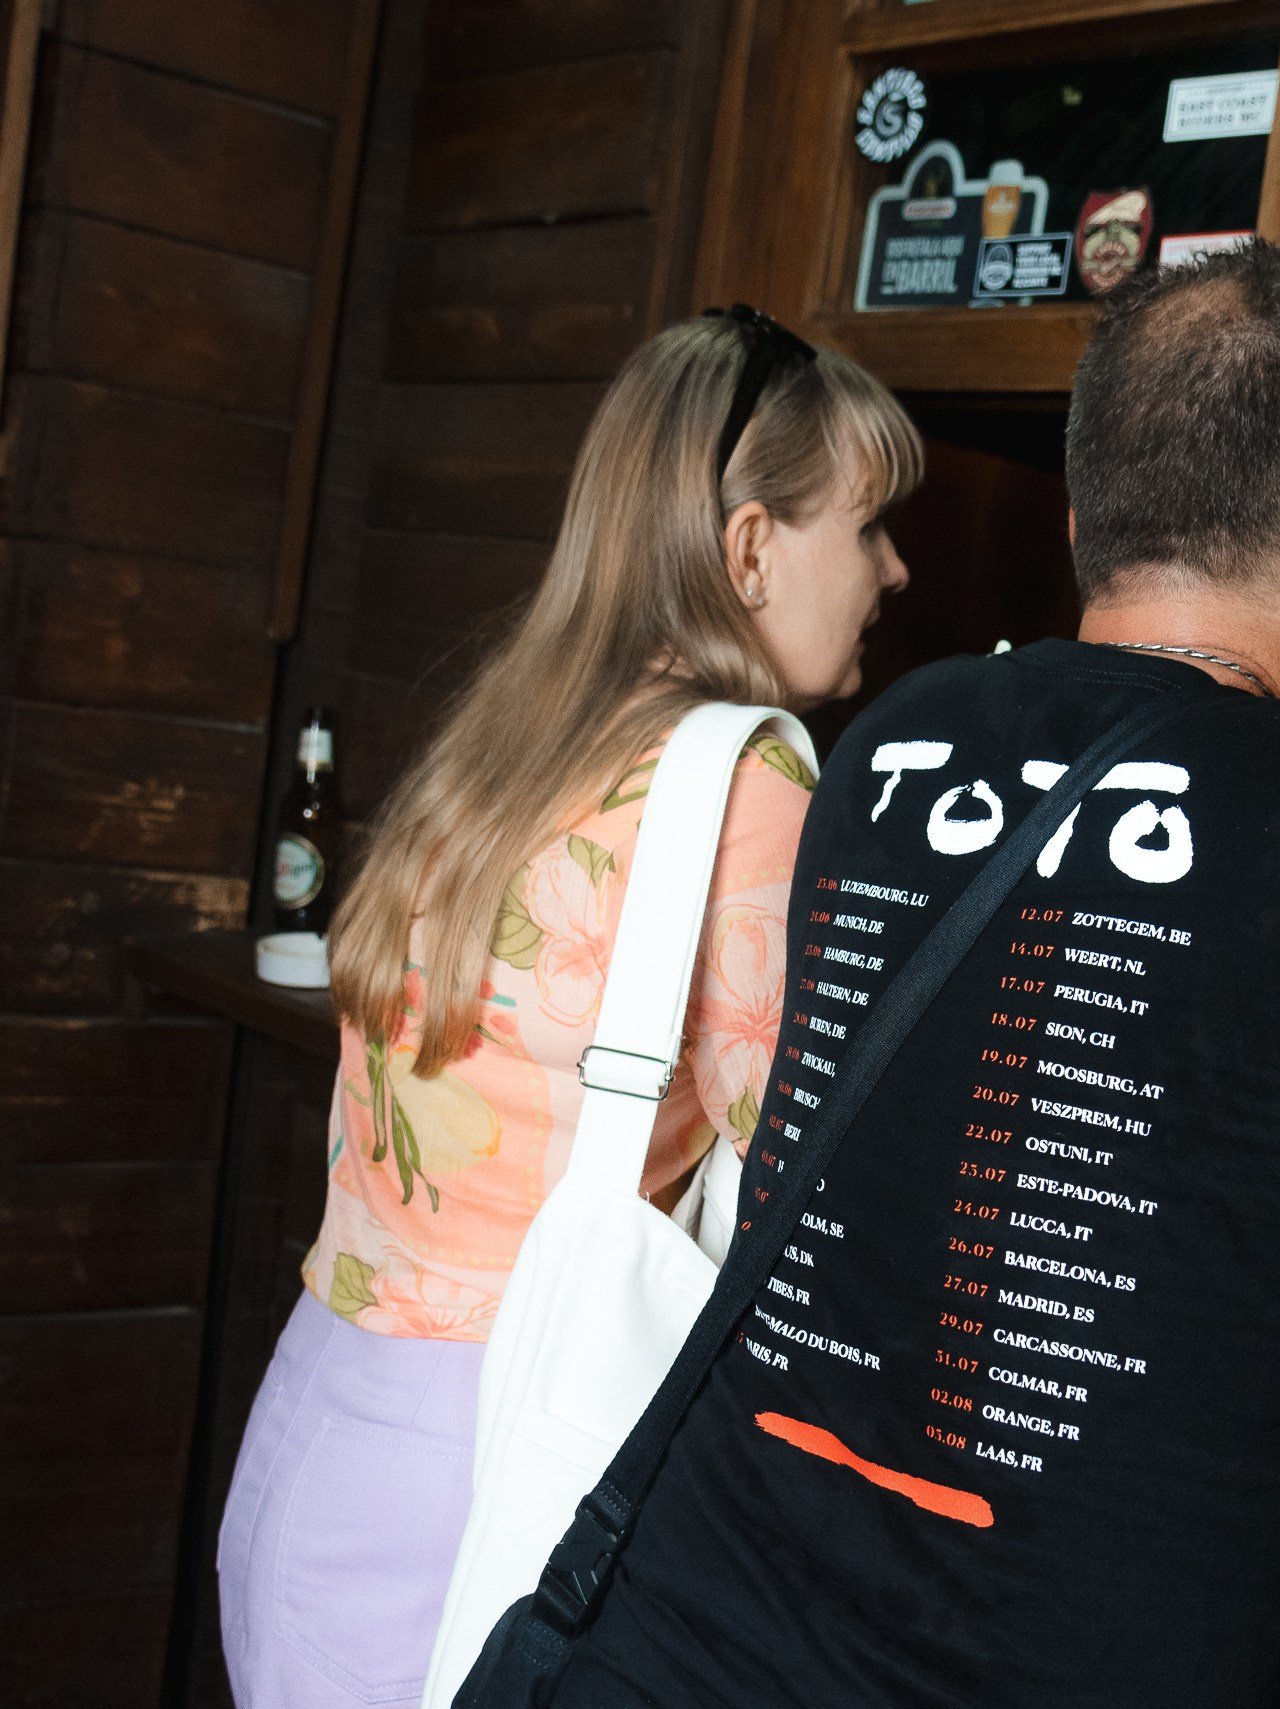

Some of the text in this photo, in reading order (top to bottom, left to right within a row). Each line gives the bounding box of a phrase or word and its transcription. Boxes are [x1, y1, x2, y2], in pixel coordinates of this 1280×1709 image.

[840, 879, 909, 905] LUXEMBOURG,
[912, 892, 929, 907] LU
[833, 914, 867, 932] MUNICH,
[867, 920, 885, 935] DE
[1021, 908, 1192, 947] 12.07 ZOTTEGEM, BE
[823, 946, 865, 970] HAMBURG,
[866, 956, 884, 972] DE
[1010, 942, 1146, 976] 14.07 WEERT, NL
[816, 981, 850, 1004] HALTERN,
[852, 989, 870, 1006] DE
[1000, 976, 1149, 1016] 17.07 PERUGIA, IT
[832, 1024, 847, 1040] DE
[991, 1012, 1116, 1050] 18.07 SION, CH
[981, 1049, 1165, 1100] 19.07 MOOSBURG, AT
[972, 1085, 1152, 1137] 20.07 VESZPREM, HU
[965, 1123, 1114, 1166] 22.07 OSTUNI, IT
[1016, 1173, 1136, 1213] ESTE-PADOVA,
[1138, 1199, 1158, 1216] IT
[800, 1212, 845, 1239] OLM, SE
[953, 1199, 1093, 1242] 24.07 LUCCA, IT
[800, 1250, 815, 1268] DK
[948, 1237, 1137, 1292] 26.07 BARCELONA, ES
[796, 1288, 810, 1306] FR
[943, 1274, 1095, 1323] 27.07 MADRID, ES
[807, 1333, 829, 1351] DU
[828, 1340, 863, 1366] BOIS,
[864, 1352, 881, 1371] FR
[939, 1311, 1147, 1374] 29.07 CARCASSONNE, FR
[772, 1353, 789, 1371] FR
[988, 1366, 1063, 1399] COLMAR,
[1064, 1385, 1088, 1403] FR
[930, 1387, 1080, 1441] 02.08 ORANGE, FR
[975, 1441, 1018, 1468] LAAS,
[1020, 1454, 1044, 1473] FR
